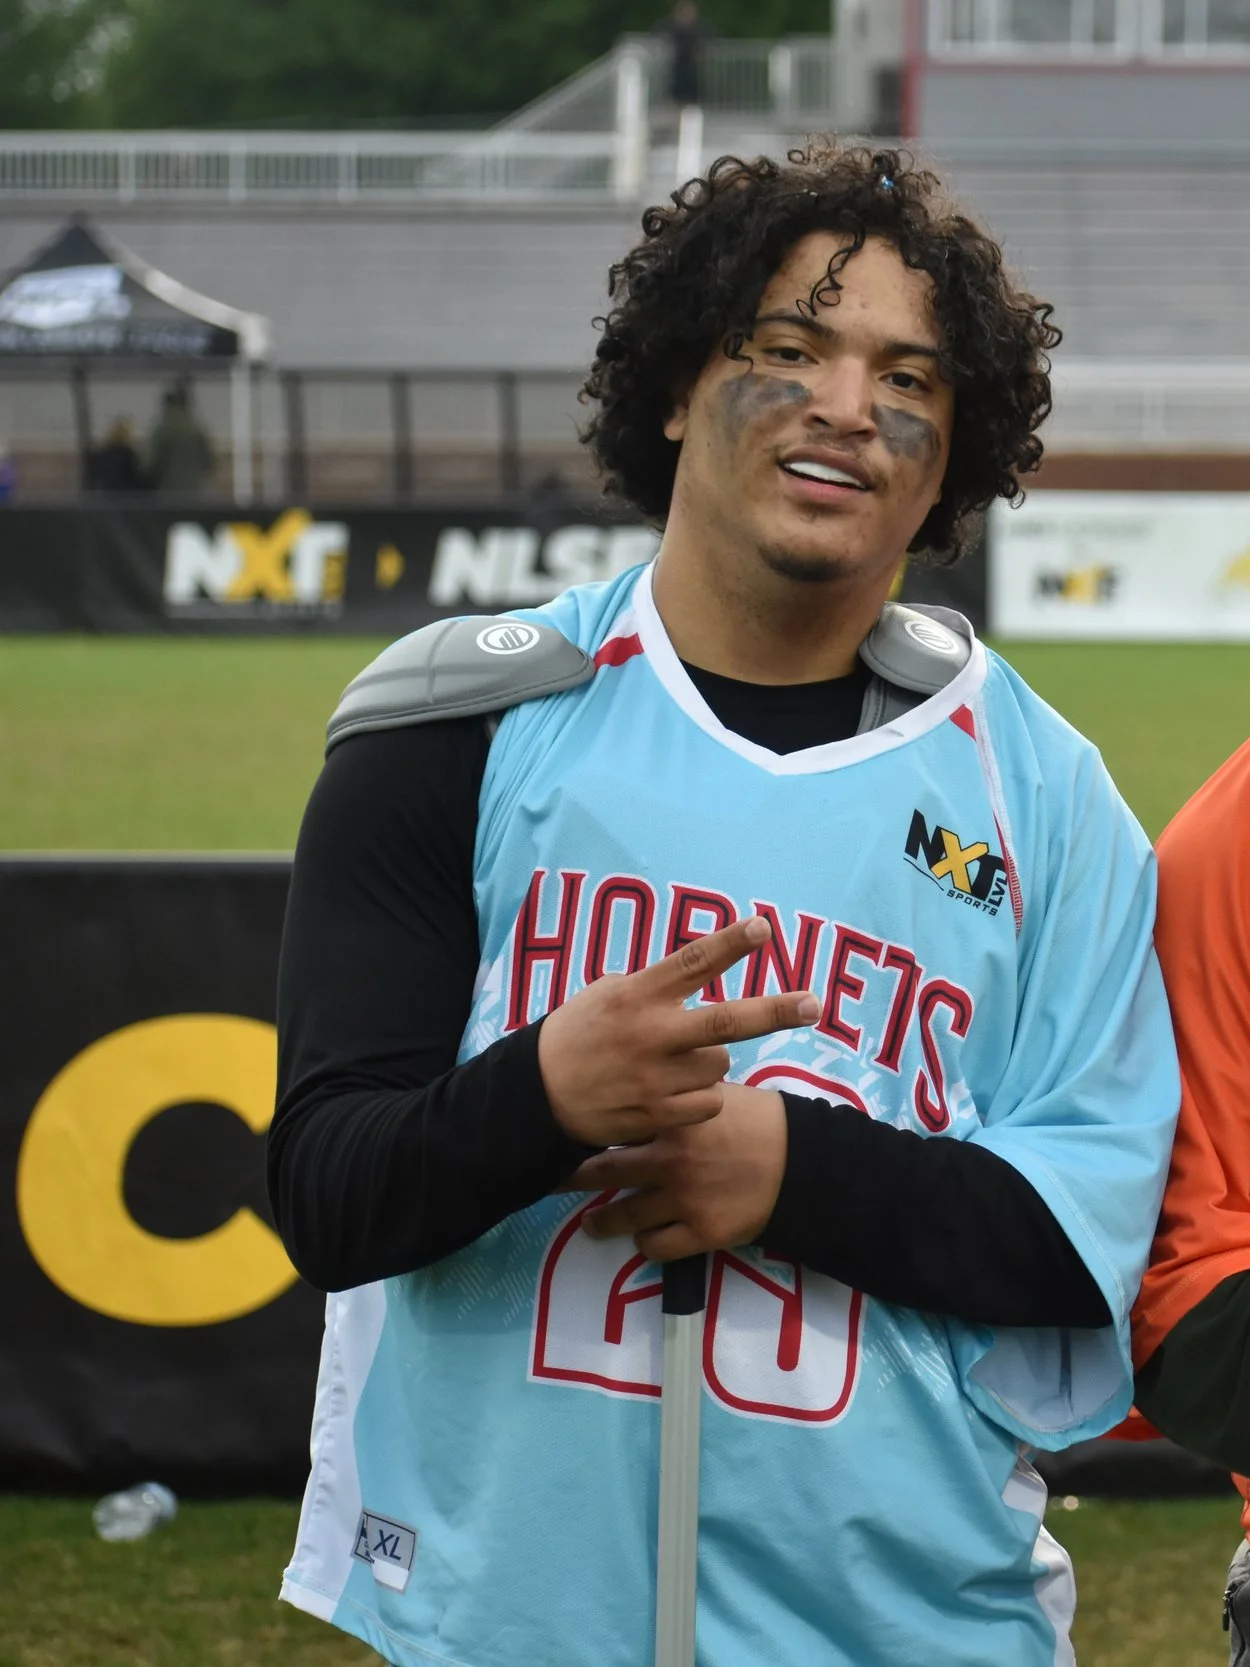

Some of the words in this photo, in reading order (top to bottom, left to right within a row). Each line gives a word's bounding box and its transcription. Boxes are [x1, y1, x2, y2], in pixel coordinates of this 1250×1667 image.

[163, 508, 349, 605] NXT
[903, 808, 1008, 901] NXT
[946, 889, 998, 917] SPORTS
[503, 868, 975, 1133] HORNETS
[15, 1011, 299, 1328] C
[373, 1529, 401, 1560] XL
